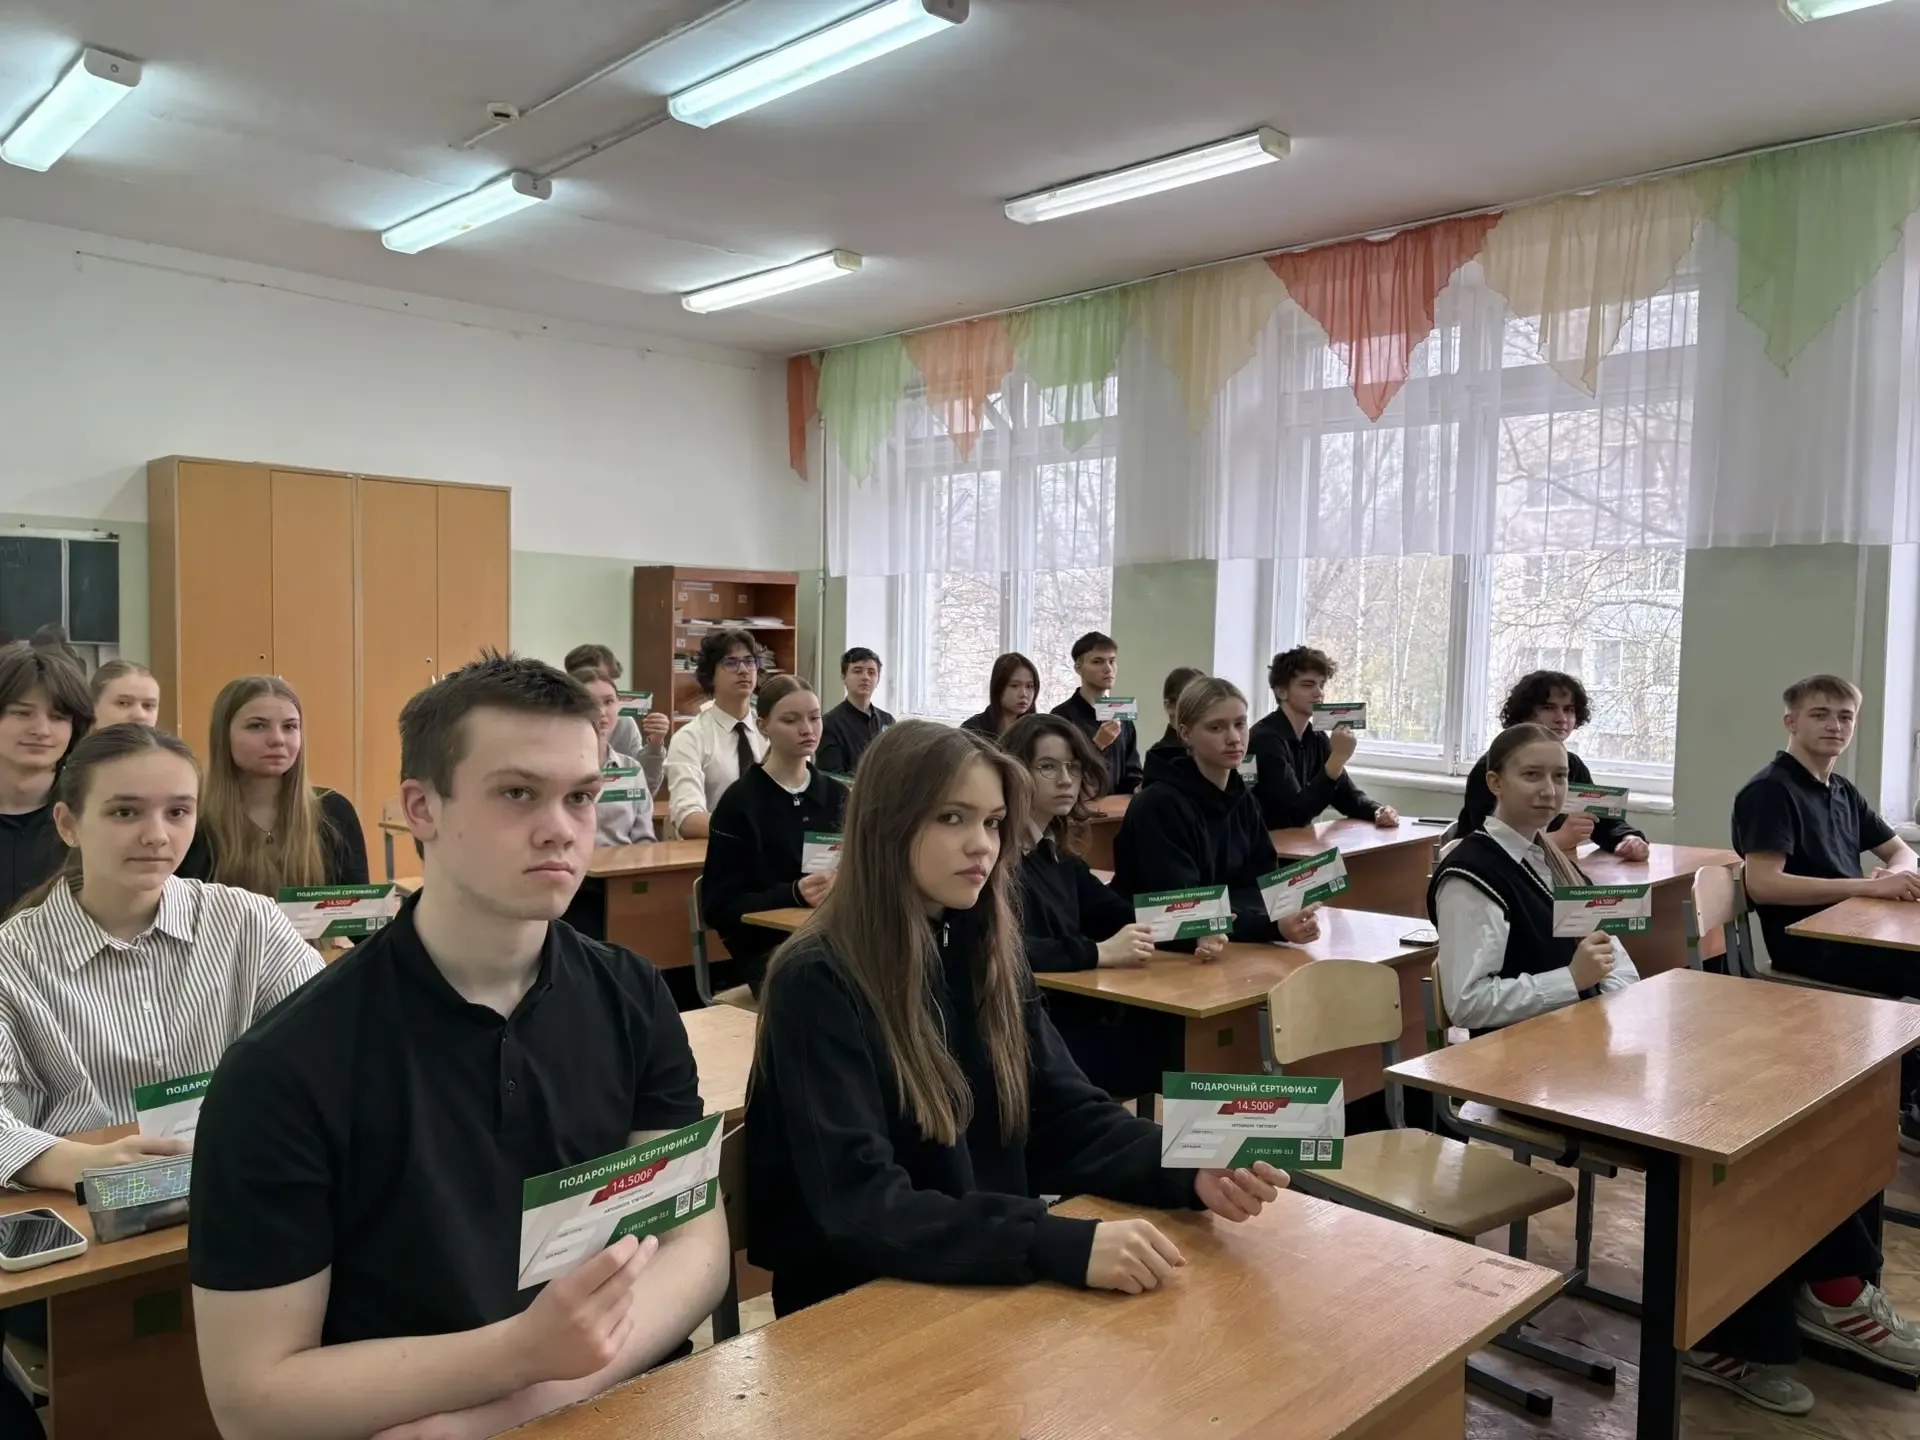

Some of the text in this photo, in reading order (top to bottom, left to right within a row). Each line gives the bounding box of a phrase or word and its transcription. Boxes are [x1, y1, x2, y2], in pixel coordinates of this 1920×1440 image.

[166, 1079, 212, 1096] ПОДАРО
[1190, 1081, 1318, 1095] ПОДАРОЧНЫЙ СЕРТИФИКАТ
[559, 1131, 700, 1190] ПОДАРОЧНЫЙ СЕРТИФИКАТ
